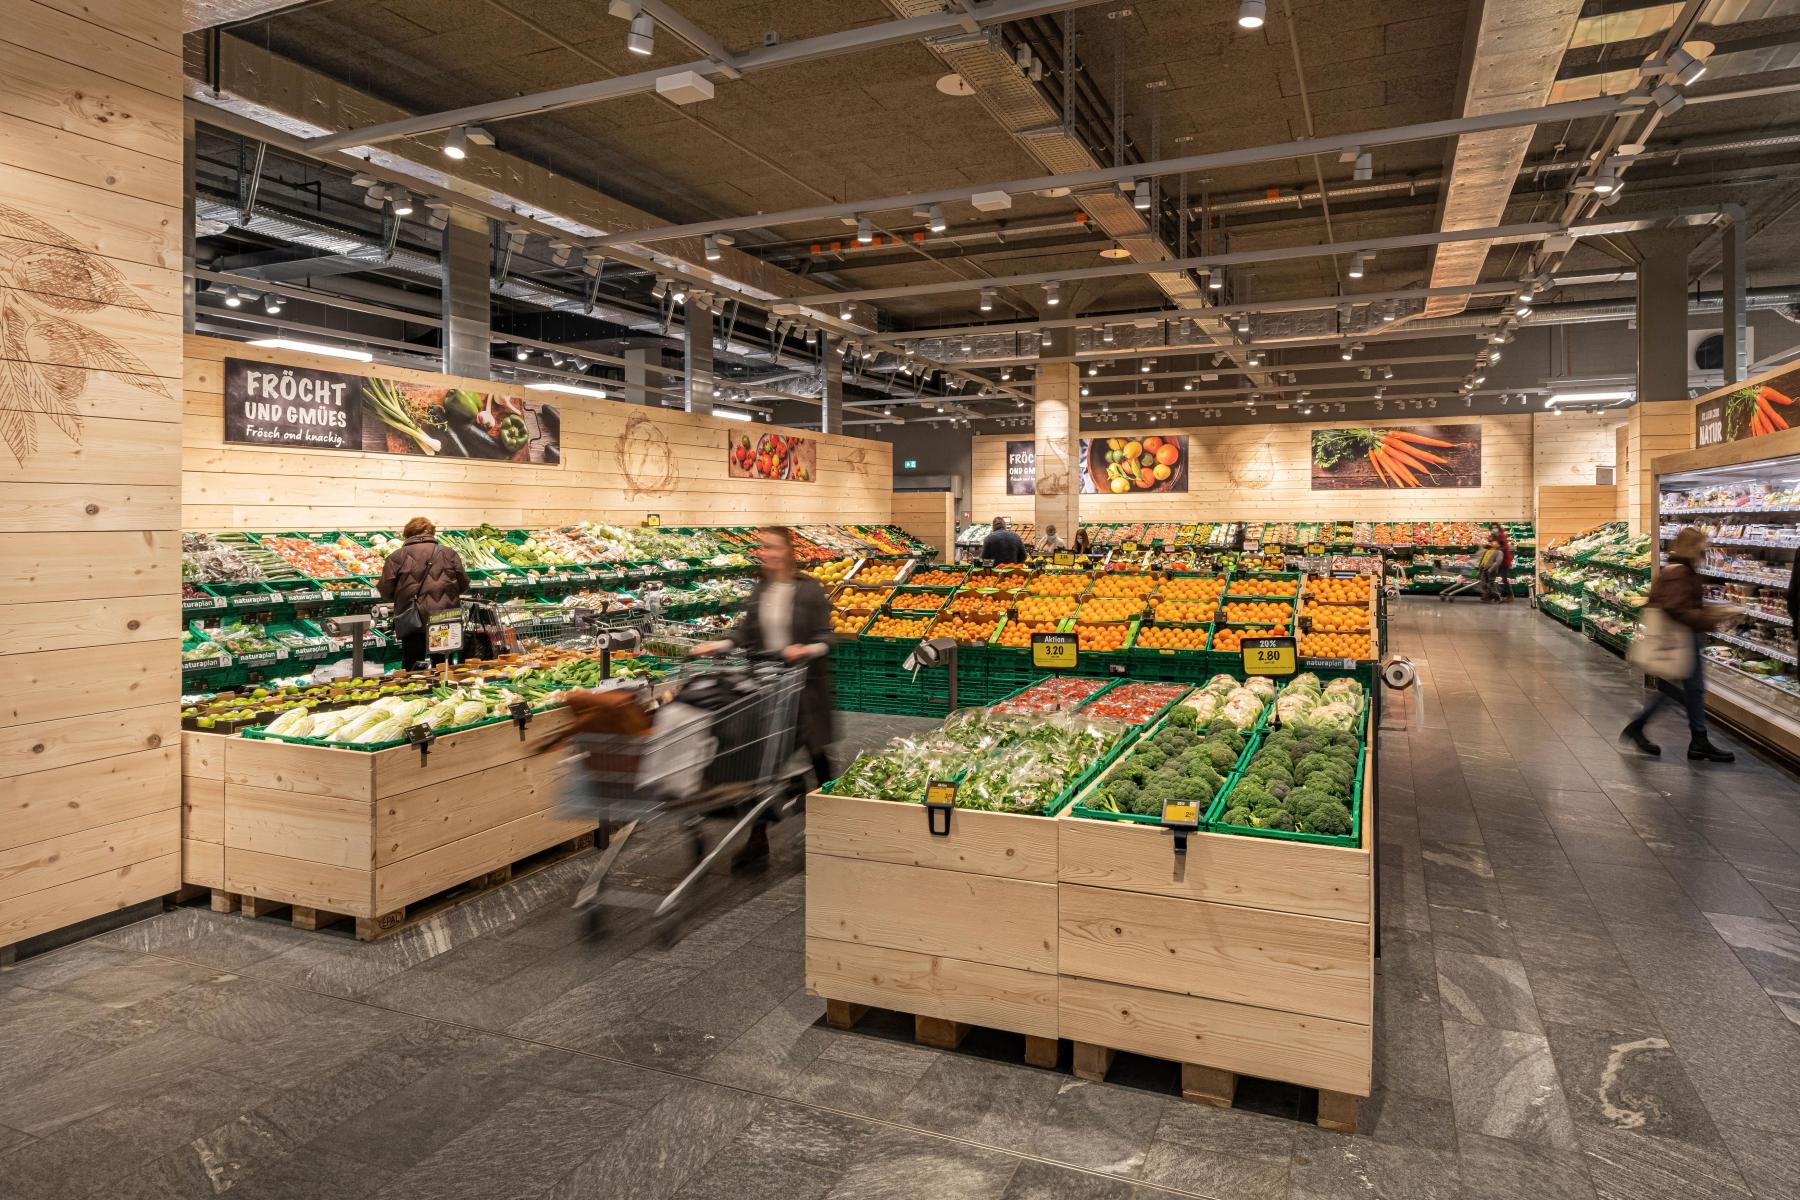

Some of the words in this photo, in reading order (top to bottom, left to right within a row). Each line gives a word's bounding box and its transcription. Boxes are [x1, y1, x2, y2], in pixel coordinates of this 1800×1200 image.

[247, 370, 346, 406] FRÖCHT
[245, 401, 282, 422] UND
[286, 405, 347, 428] GMÜES
[246, 424, 280, 439] Frösch
[283, 429, 303, 441] ond
[305, 429, 345, 447] knackig.
[1699, 420, 1723, 446] NATUR
[1009, 451, 1035, 464] FRÖC
[182, 600, 213, 609] turaplan
[233, 596, 270, 605] naturaplan
[1044, 635, 1065, 643] Aktion
[1259, 639, 1277, 648] 20%
[295, 645, 328, 655] naturaplan
[1045, 645, 1064, 655] 3.20
[240, 651, 276, 661] naturaplan
[1257, 650, 1280, 661] 2.80
[1306, 660, 1342, 669] naturaplan
